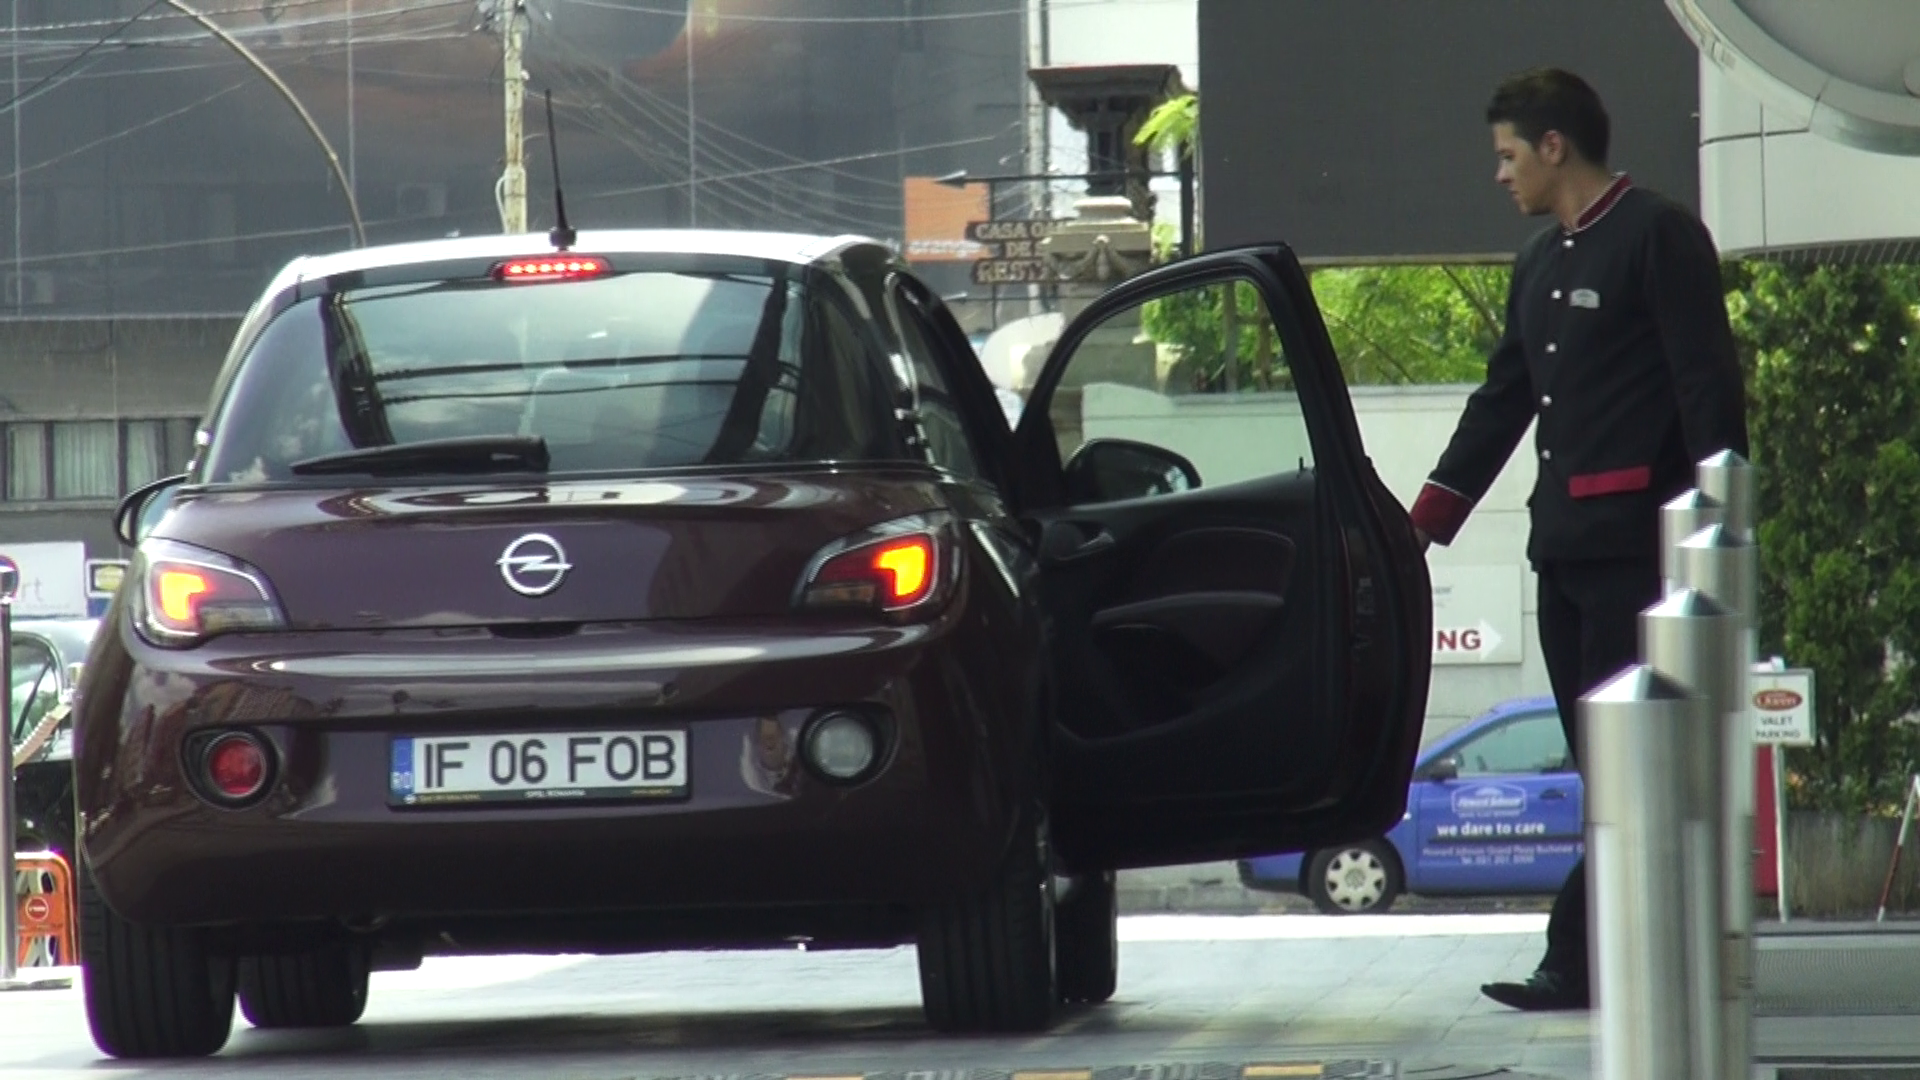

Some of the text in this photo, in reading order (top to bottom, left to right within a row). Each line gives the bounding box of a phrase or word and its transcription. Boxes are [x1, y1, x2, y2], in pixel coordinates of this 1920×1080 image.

[975, 222, 1027, 240] CASA
[1005, 241, 1032, 258] DE
[1436, 629, 1481, 651] NG
[1761, 715, 1793, 726] VALET
[1755, 729, 1801, 738] PARKING
[424, 735, 676, 788] IF 06 FOB
[1437, 821, 1546, 837] we dare to care
